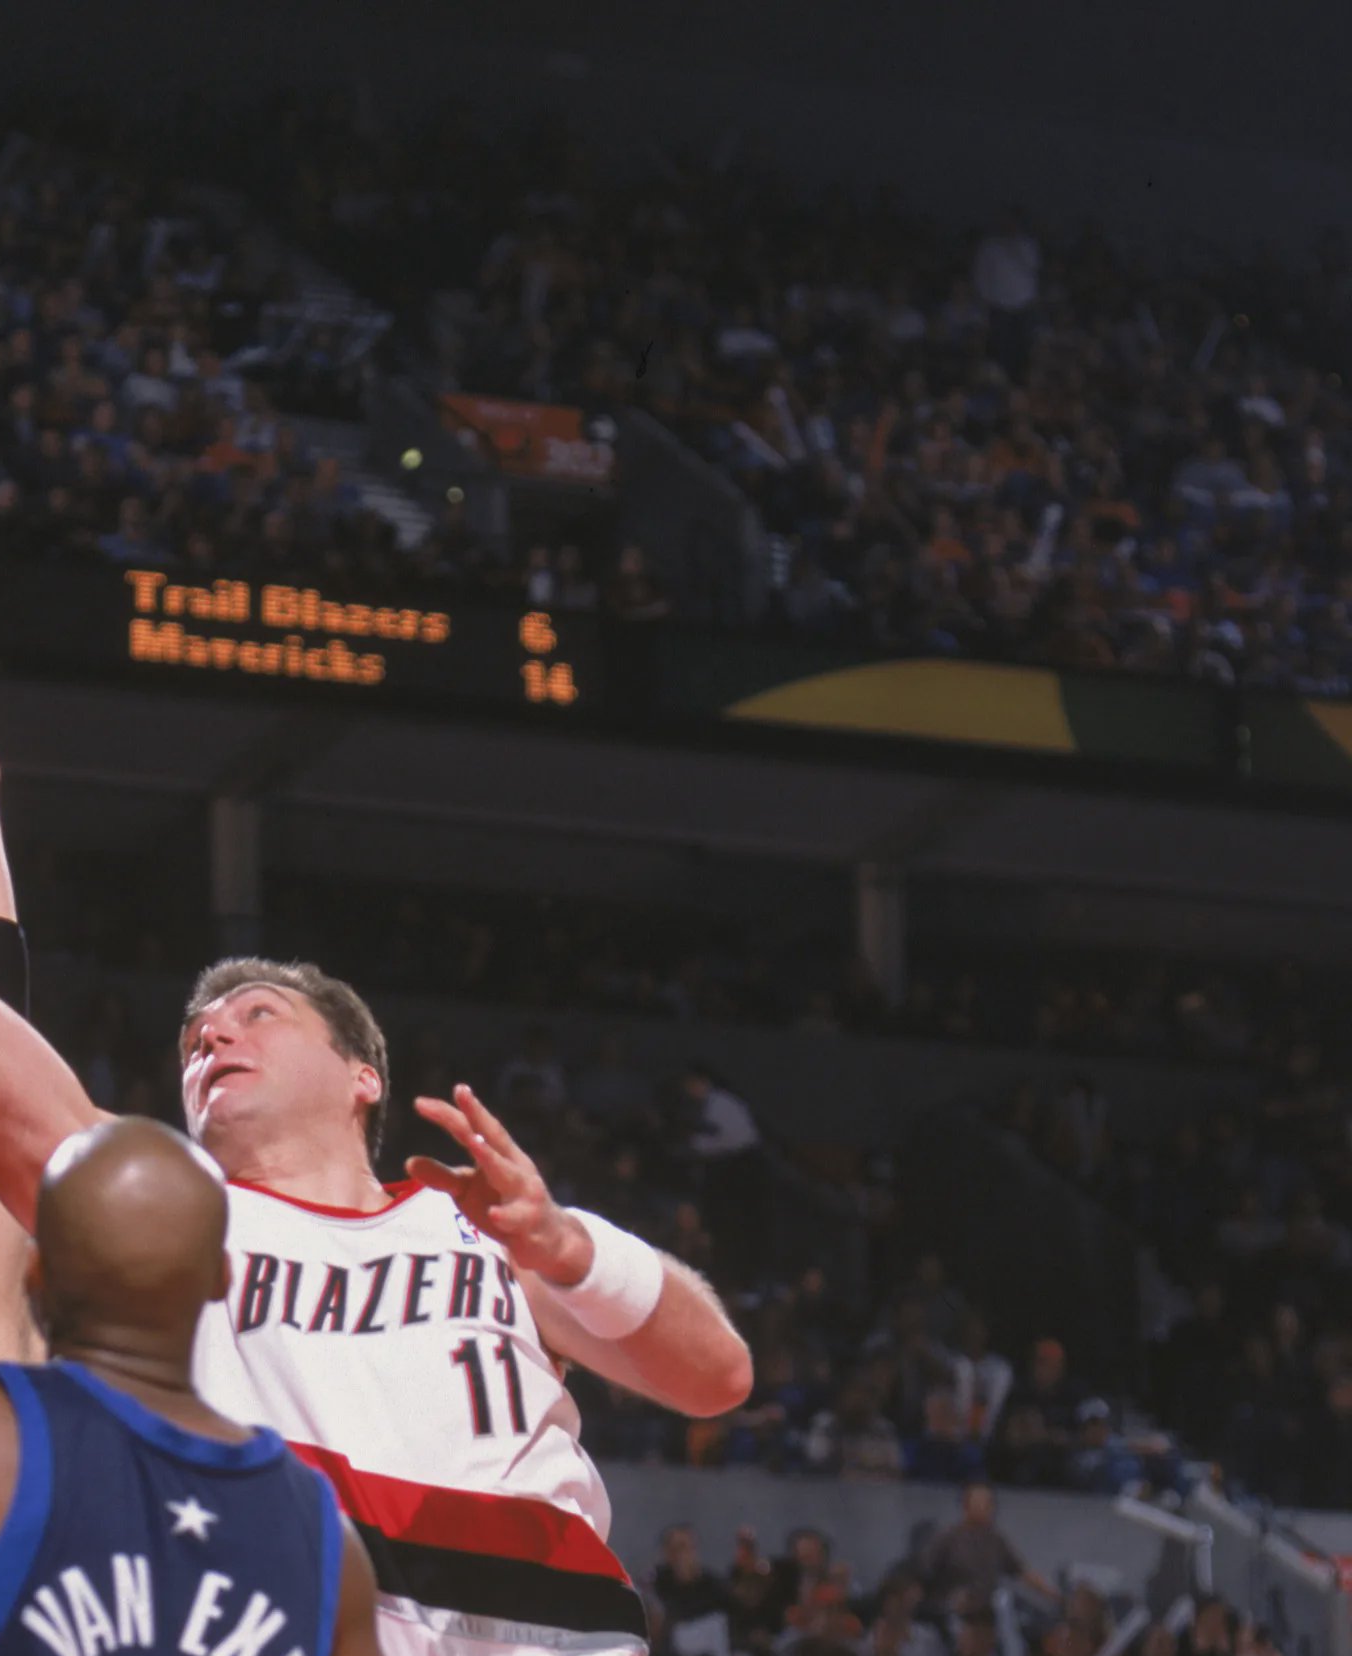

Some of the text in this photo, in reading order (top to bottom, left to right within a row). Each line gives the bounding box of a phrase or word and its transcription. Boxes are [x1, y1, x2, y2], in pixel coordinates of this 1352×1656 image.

[124, 568, 249, 623] Trail
[260, 583, 450, 644] Blazers
[128, 617, 386, 685] Mavericks
[235, 1250, 517, 1334] BLAZERS
[449, 1336, 529, 1437] 11
